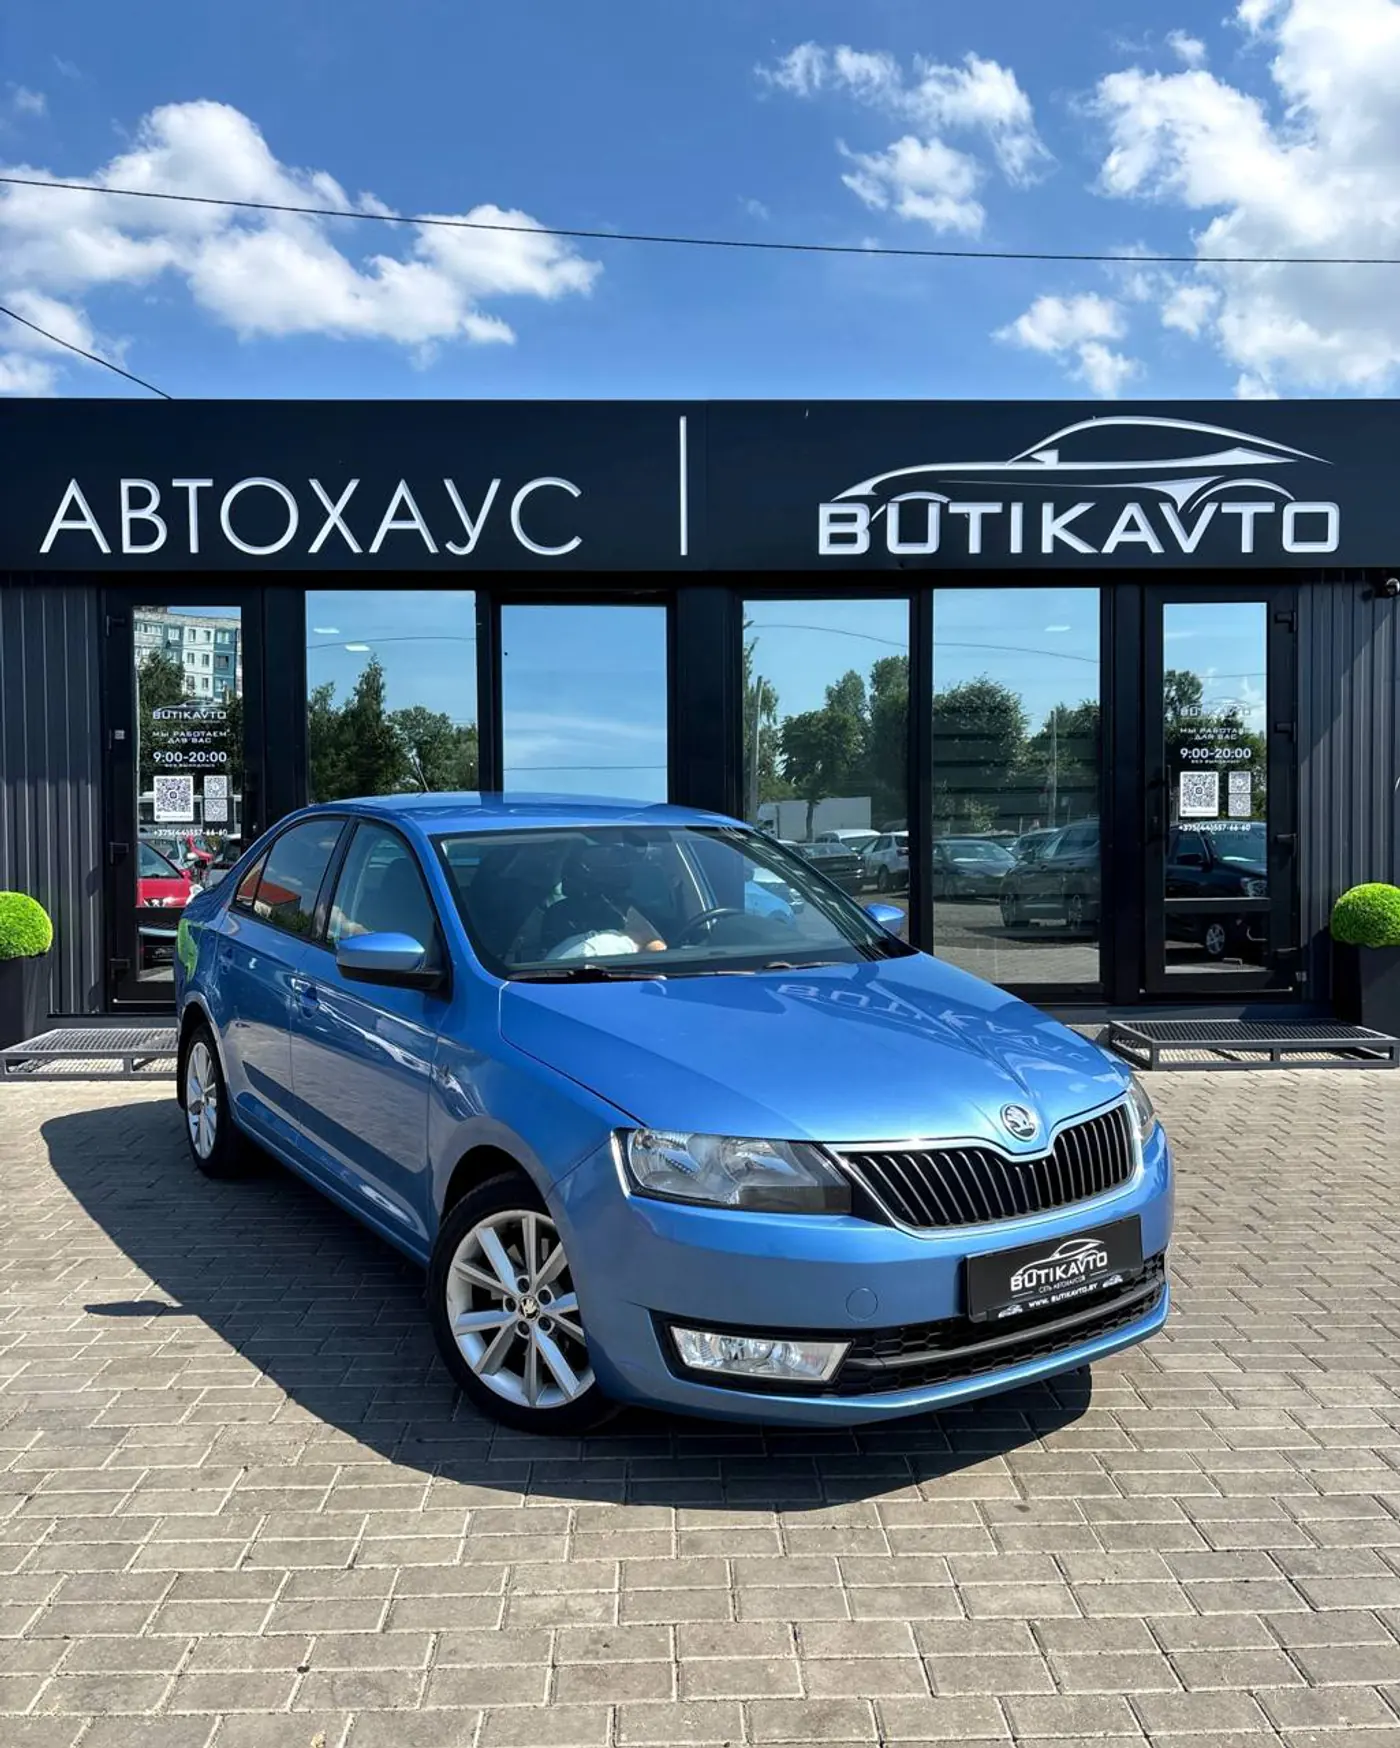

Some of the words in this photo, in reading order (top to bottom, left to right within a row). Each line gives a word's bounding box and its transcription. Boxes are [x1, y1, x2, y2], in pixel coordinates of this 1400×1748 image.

[39, 476, 582, 556] АВТОХАУС
[818, 500, 1340, 556] BUTIKAVTO
[153, 711, 227, 720] BUTIKAVTO
[153, 751, 227, 763] 9:00-20:00
[1180, 748, 1251, 759] 9:00-20:00
[1010, 1251, 1108, 1291] BUTIKAVTO
